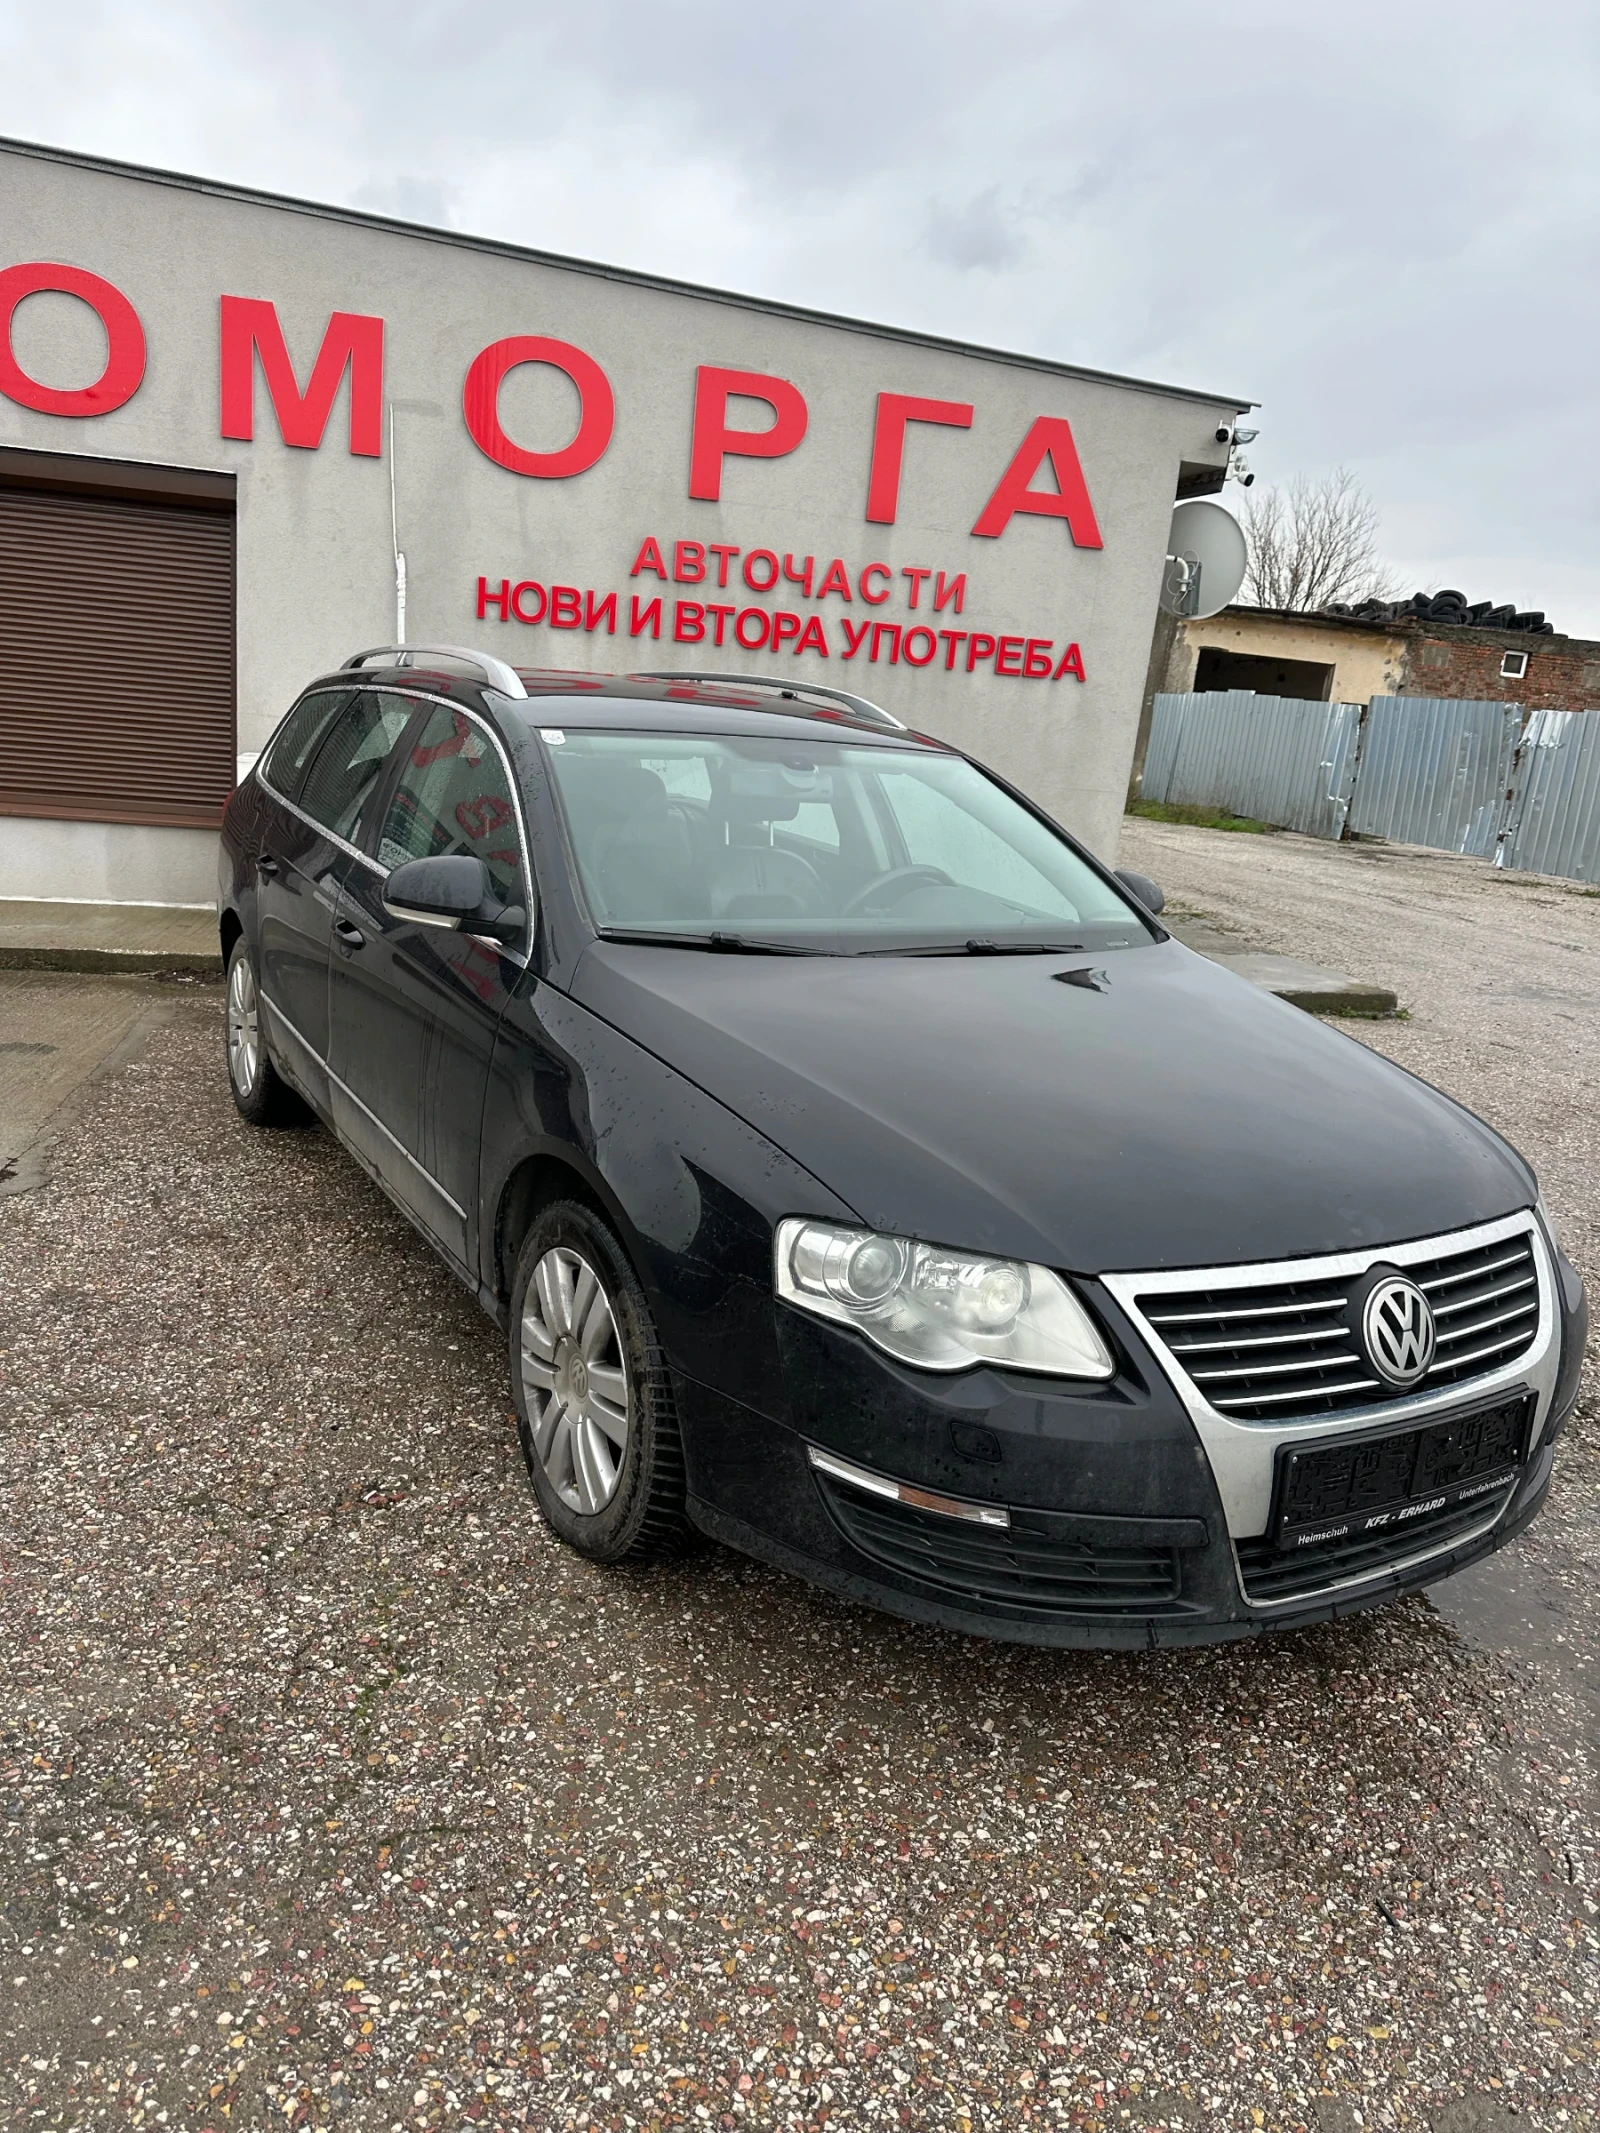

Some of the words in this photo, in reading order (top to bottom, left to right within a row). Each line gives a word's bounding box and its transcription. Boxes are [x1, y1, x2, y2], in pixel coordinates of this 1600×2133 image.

[631, 536, 968, 615] АВТОЧАСТИ
[476, 576, 618, 636] НОВИ
[629, 595, 662, 640] И
[673, 600, 831, 658] ВТОРА
[842, 617, 1087, 682] УПОТРЕБА
[1297, 1525, 1349, 1545] Heimschuh
[1364, 1513, 1390, 1529] KFZ
[1398, 1497, 1446, 1519] ERHARD
[1459, 1472, 1515, 1500] Unterfahrenbach
